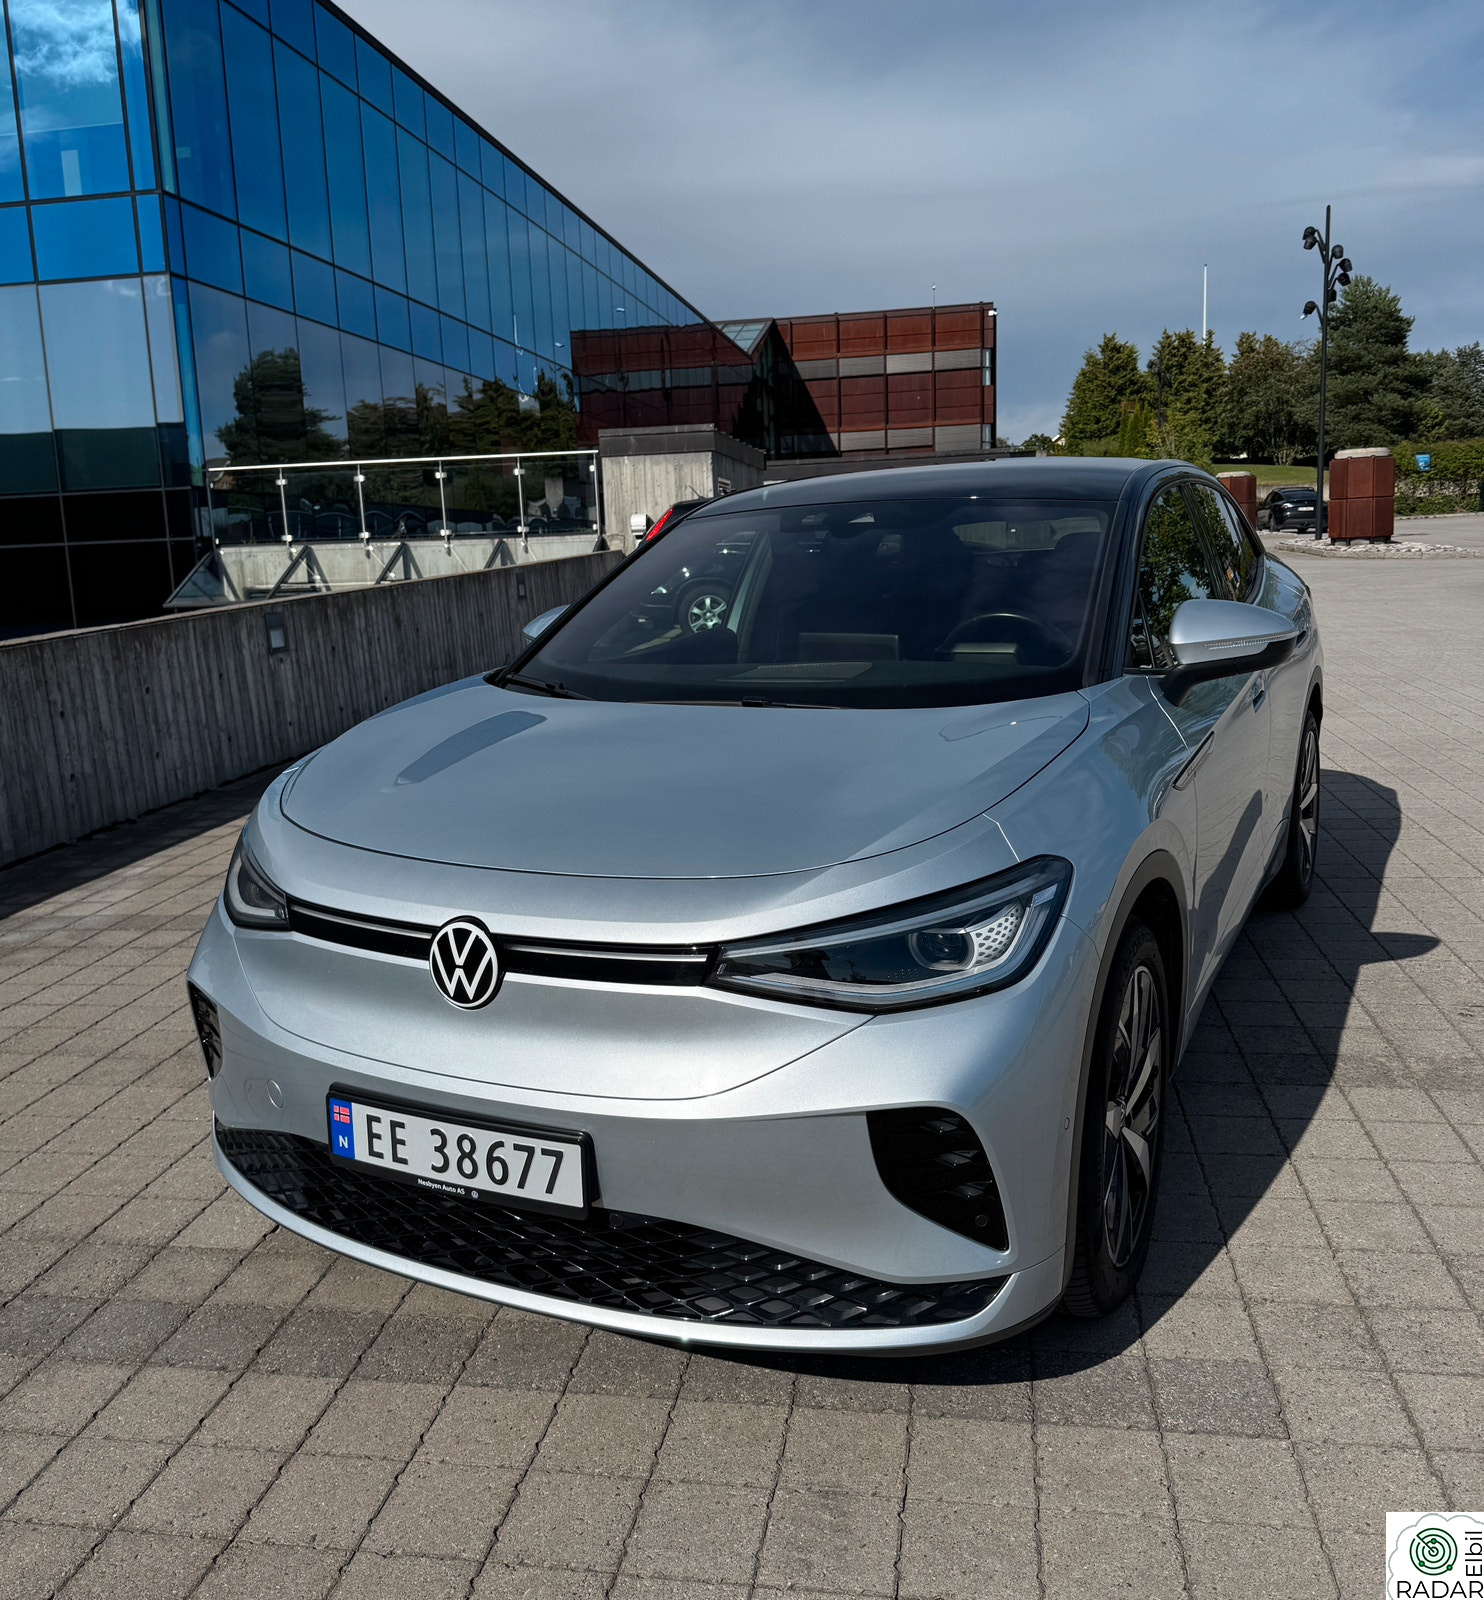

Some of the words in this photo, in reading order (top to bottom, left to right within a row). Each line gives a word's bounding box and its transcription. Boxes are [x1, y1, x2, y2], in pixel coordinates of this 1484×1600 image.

[431, 923, 497, 1005] VW
[338, 1135, 349, 1150] N
[366, 1113, 409, 1166] EE
[429, 1128, 564, 1195] 38677
[417, 1178, 442, 1189] Nesbyen
[442, 1184, 457, 1193] Auto
[456, 1187, 466, 1195] AS
